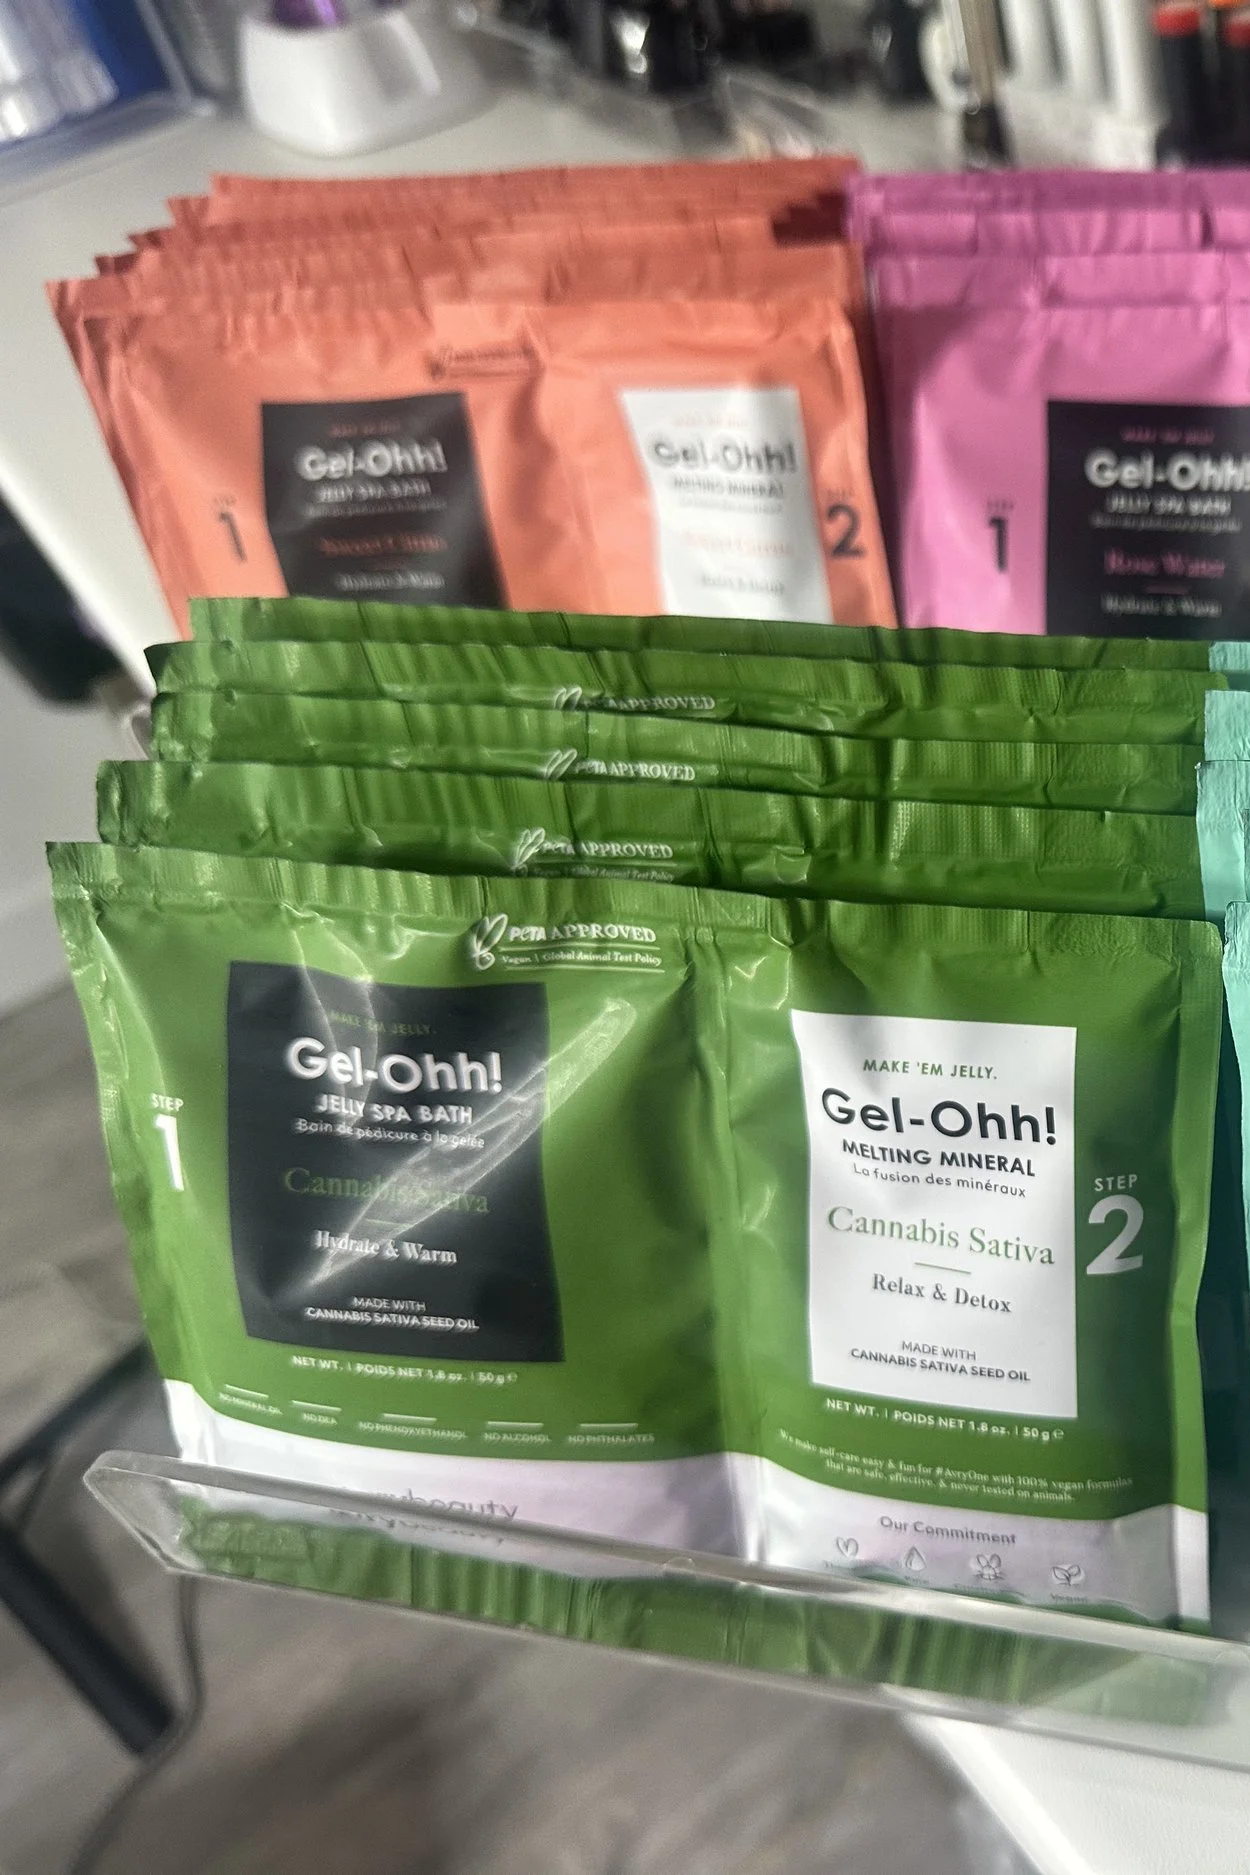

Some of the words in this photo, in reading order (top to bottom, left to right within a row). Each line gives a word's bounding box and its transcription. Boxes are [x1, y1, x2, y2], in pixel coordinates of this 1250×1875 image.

[827, 504, 863, 558] 2
[989, 517, 1007, 573] 1
[551, 924, 656, 941] APPROVED
[502, 954, 531, 966] Vegan
[543, 949, 575, 962] Global
[577, 951, 611, 962] Animal
[614, 952, 632, 963] Test
[634, 953, 662, 966] Policy
[285, 1036, 503, 1093] Gel-Ohh!
[863, 1059, 909, 1073] MAKE
[917, 1062, 943, 1076] 'EM
[950, 1065, 997, 1080] JELLY.
[151, 1092, 183, 1112] STEP
[316, 1092, 365, 1118] JELLY
[373, 1103, 410, 1122] SPA
[419, 1105, 473, 1125] BATH
[822, 1088, 1056, 1146] Gel-Ohh!
[296, 1119, 334, 1134] Bain
[341, 1121, 354, 1136] de
[437, 1133, 449, 1145] la
[155, 1115, 184, 1192] 1
[842, 1139, 932, 1165] MELTING
[940, 1151, 1036, 1176] MINERAL
[854, 1163, 870, 1177] La
[874, 1168, 920, 1184] fusion
[926, 1173, 951, 1185] des
[957, 1176, 1026, 1197] minéraux
[1094, 1174, 1138, 1192] STEP
[314, 1230, 380, 1257] Hydrate
[384, 1240, 400, 1258] &
[403, 1241, 457, 1264] Warm
[828, 1205, 960, 1249] Cannabis
[969, 1226, 1055, 1264] Sativa
[1086, 1194, 1144, 1274] 2
[353, 1297, 392, 1310] MADE
[393, 1298, 426, 1312] WITH
[873, 1273, 924, 1298] Relax
[932, 1284, 947, 1301] &
[955, 1287, 1012, 1313] Detox
[305, 1306, 372, 1323] CANNABIS
[374, 1312, 421, 1327] SATIVA
[423, 1315, 454, 1329] SEED
[457, 1318, 479, 1330] OIL
[293, 1355, 316, 1369] NET
[356, 1363, 395, 1377] POIDS
[400, 1367, 423, 1379] NET
[851, 1348, 917, 1368] CANNABIS
[920, 1358, 968, 1375] SATIVA
[971, 1366, 1005, 1379] SEED
[1008, 1370, 1031, 1382] OIL
[902, 1340, 938, 1356] MADE
[942, 1348, 976, 1361] WITH
[827, 1398, 851, 1411] NET
[855, 1403, 880, 1417] WT.
[894, 1410, 934, 1425] POIDS
[938, 1415, 966, 1432] NET
[969, 1420, 988, 1432] 1.8
[992, 1426, 1009, 1435] oz.
[1023, 1427, 1038, 1438] 50
[1042, 1430, 1049, 1441] g
[826, 1460, 844, 1471] that
[848, 1466, 862, 1474] are
[880, 1515, 908, 1533] Our
[913, 1521, 1017, 1545] Commitment
